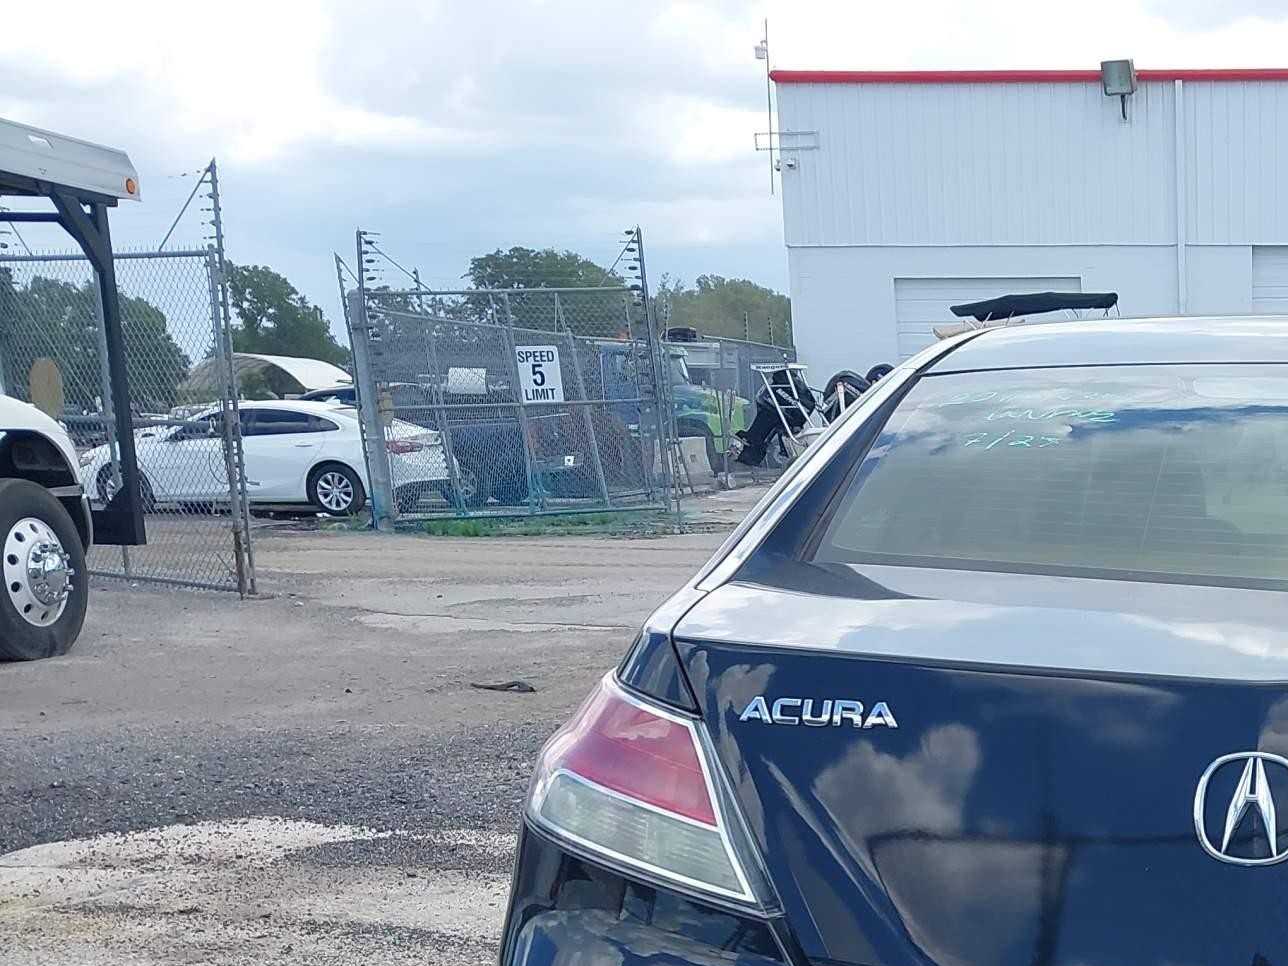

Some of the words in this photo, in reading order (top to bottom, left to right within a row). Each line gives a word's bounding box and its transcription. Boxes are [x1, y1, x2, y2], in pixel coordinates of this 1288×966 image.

[518, 350, 554, 363] SPEED
[531, 363, 545, 386] 5
[525, 388, 556, 401] LIMIT
[738, 696, 899, 729] ACURA
